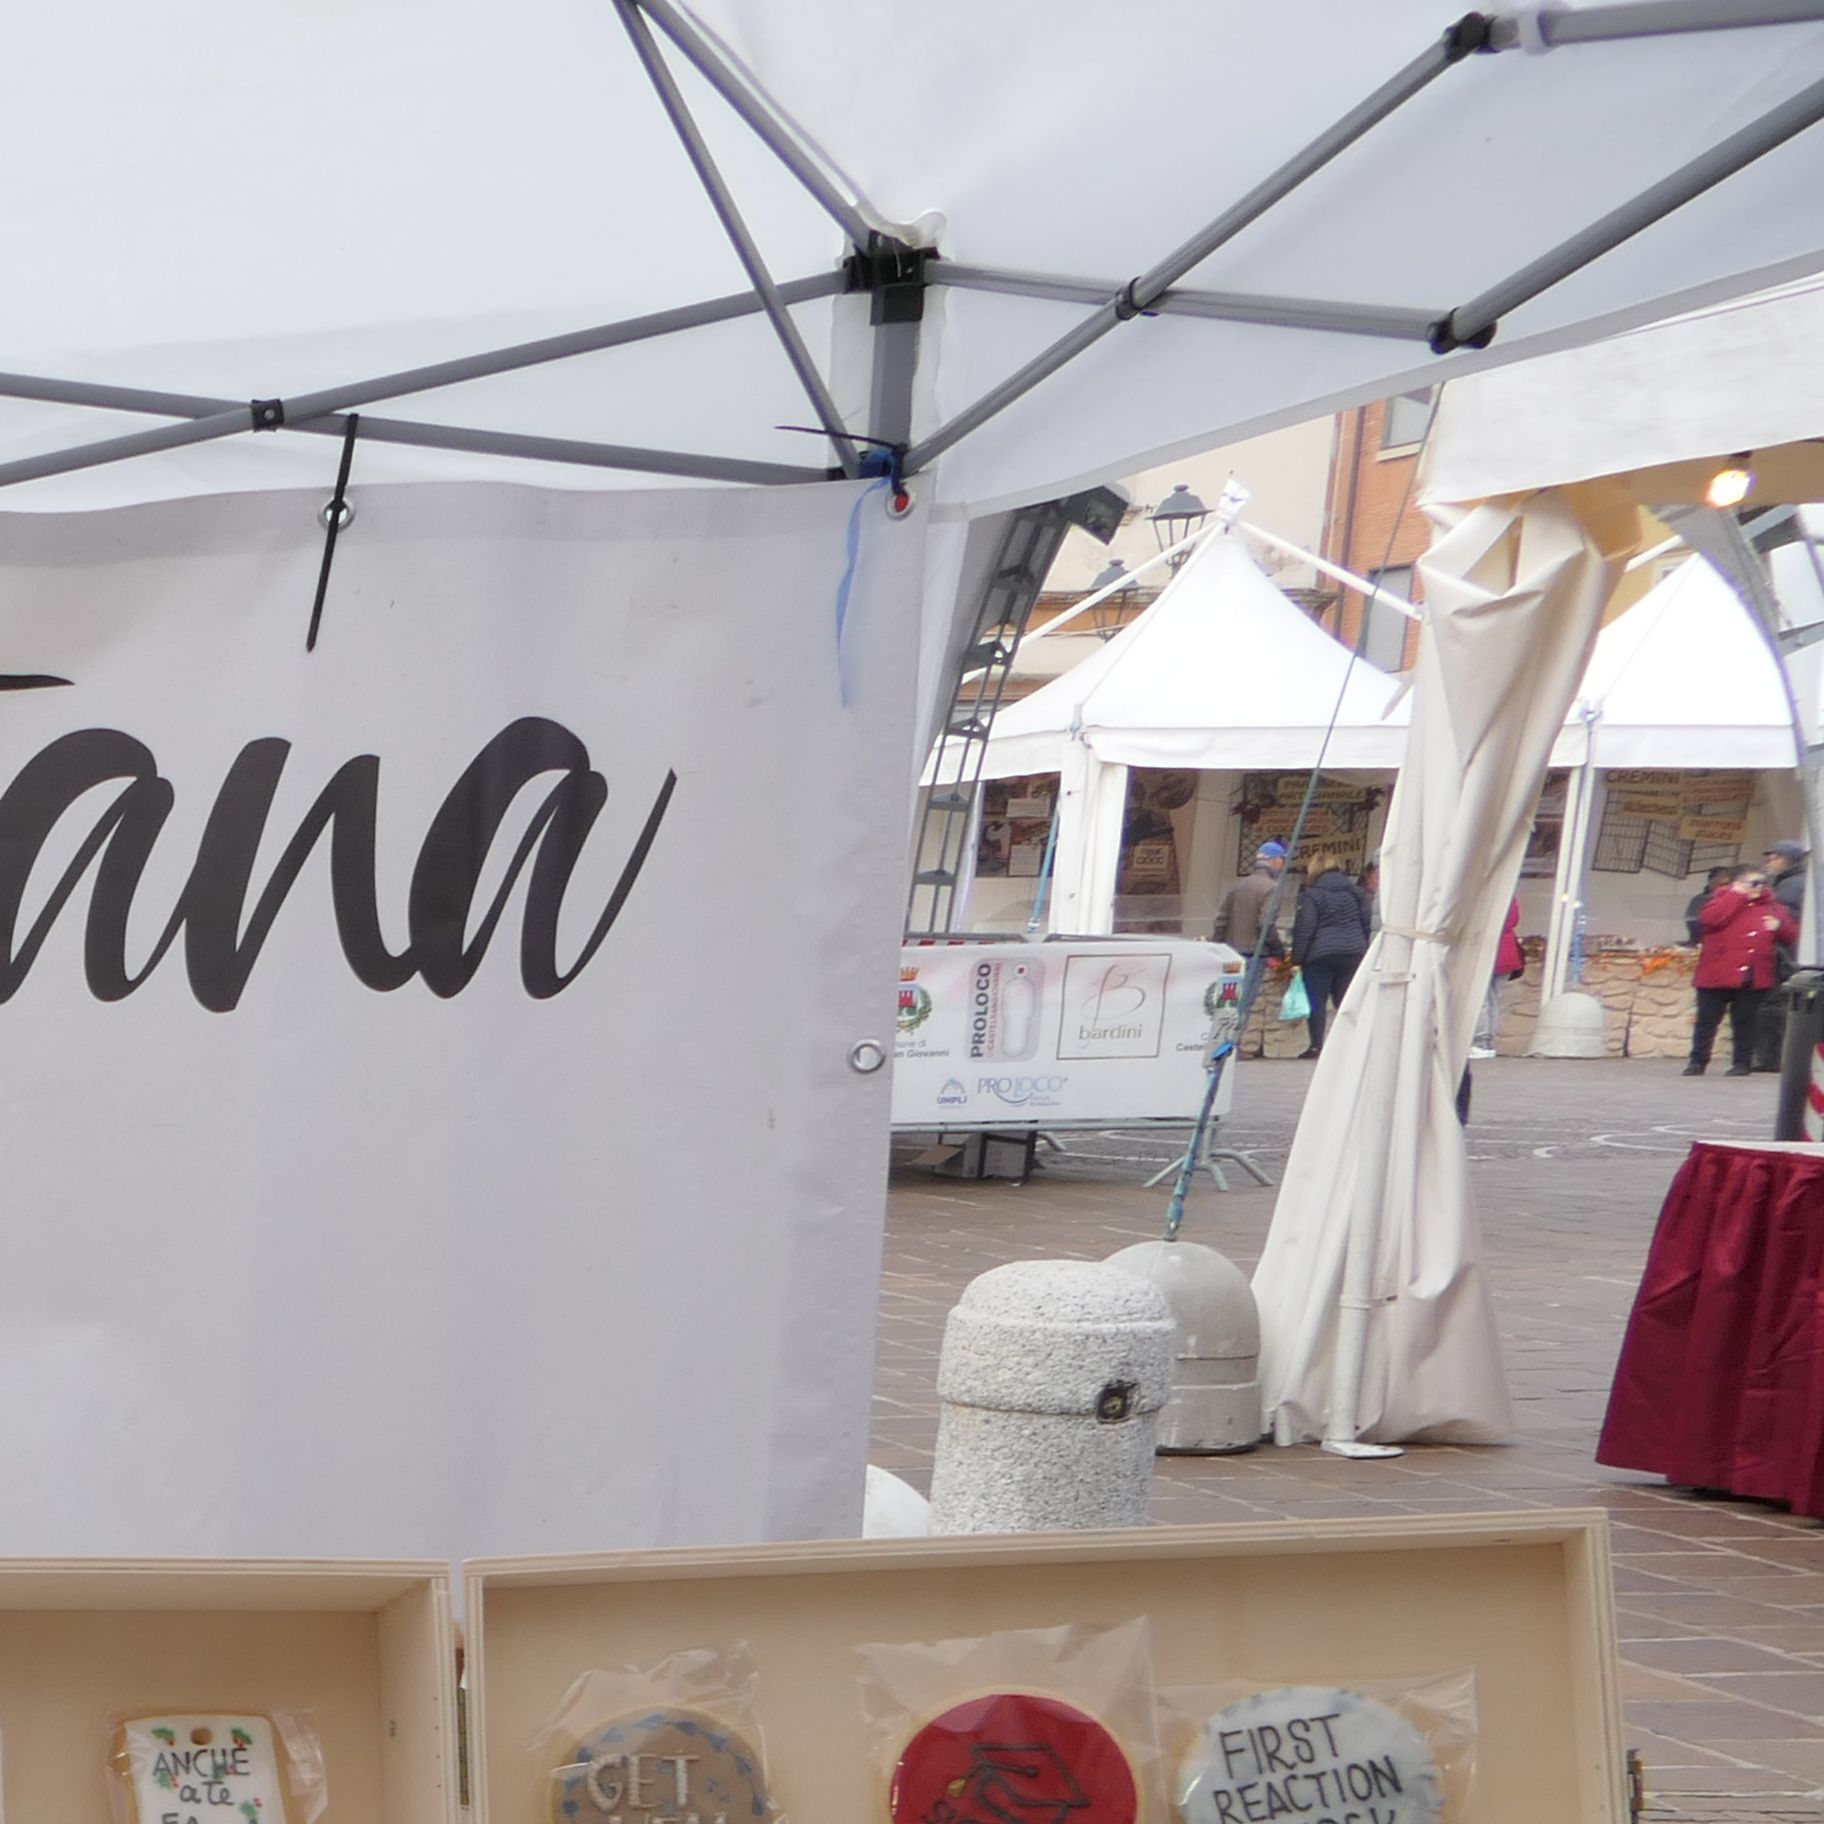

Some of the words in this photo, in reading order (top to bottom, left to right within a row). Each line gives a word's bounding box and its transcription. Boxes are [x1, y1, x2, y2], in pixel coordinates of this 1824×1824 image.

[970, 963, 992, 1058] PROLOCO
[1079, 1023, 1143, 1040] bardini
[152, 1748, 252, 1778] ANCHE
[1219, 1713, 1342, 1780] FIRST
[587, 1752, 701, 1813] GET
